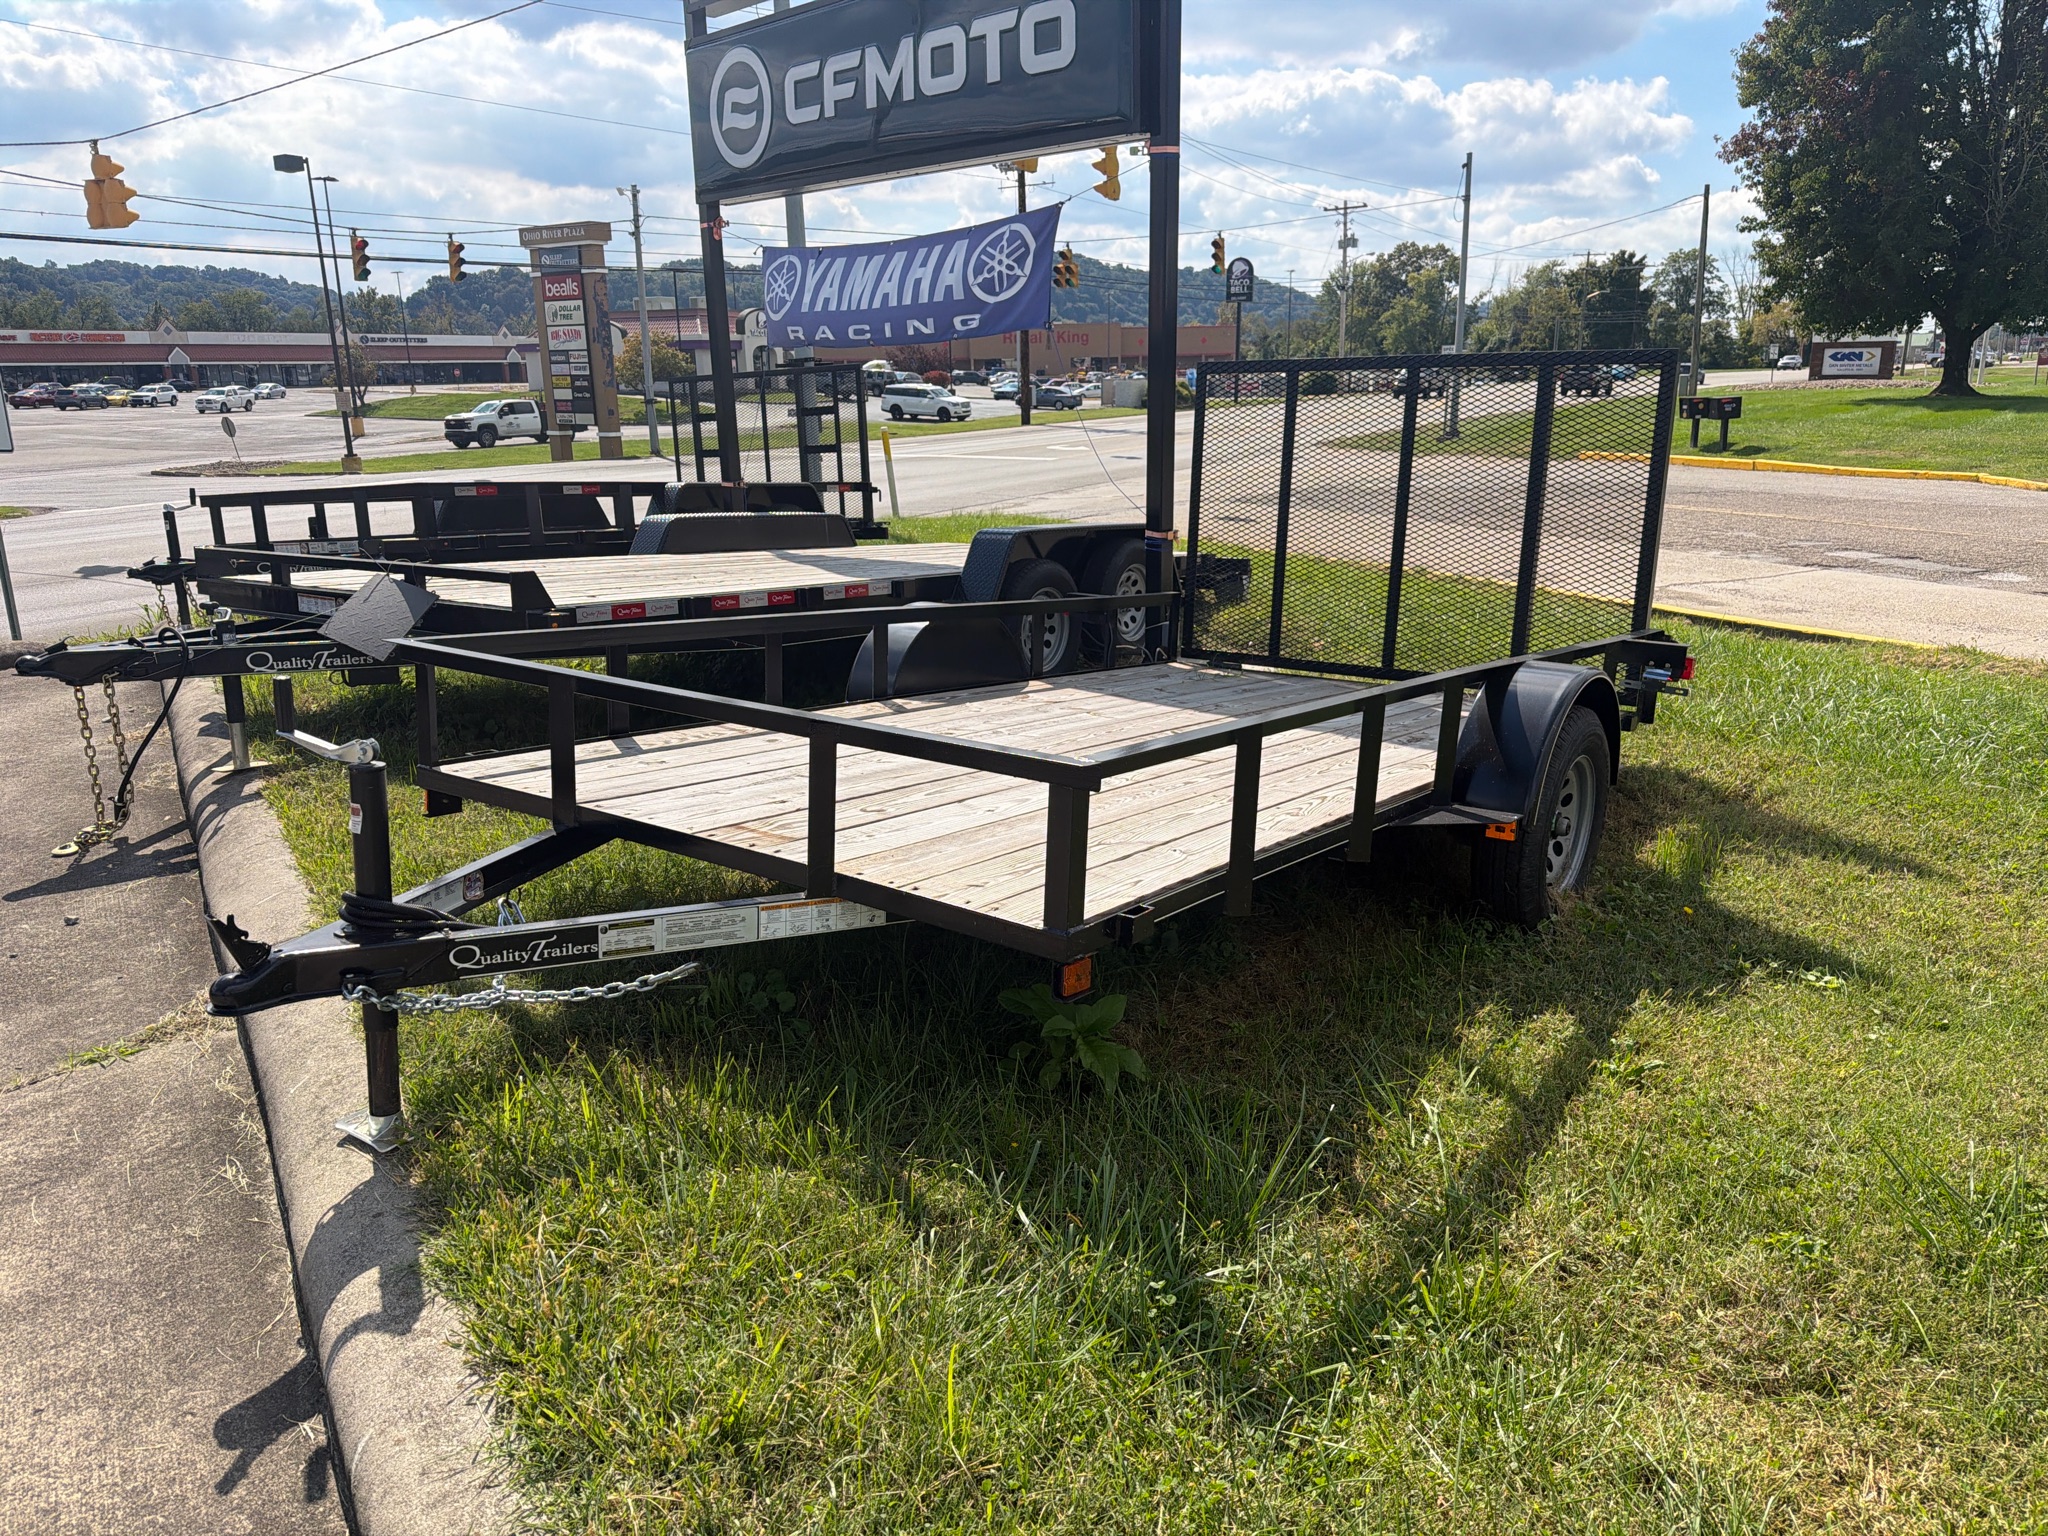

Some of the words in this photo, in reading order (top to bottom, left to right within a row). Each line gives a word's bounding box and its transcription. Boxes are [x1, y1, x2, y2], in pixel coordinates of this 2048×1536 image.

[784, 0, 1077, 125] CFMOTO
[522, 231, 541, 241] OHIO
[542, 229, 562, 239] RIVER
[563, 227, 585, 237] PLAZA
[800, 238, 969, 313] YAMAHA
[545, 278, 579, 297] bealls
[1230, 286, 1249, 294] BELL
[786, 313, 982, 342] RACING
[1056, 330, 1090, 346] King
